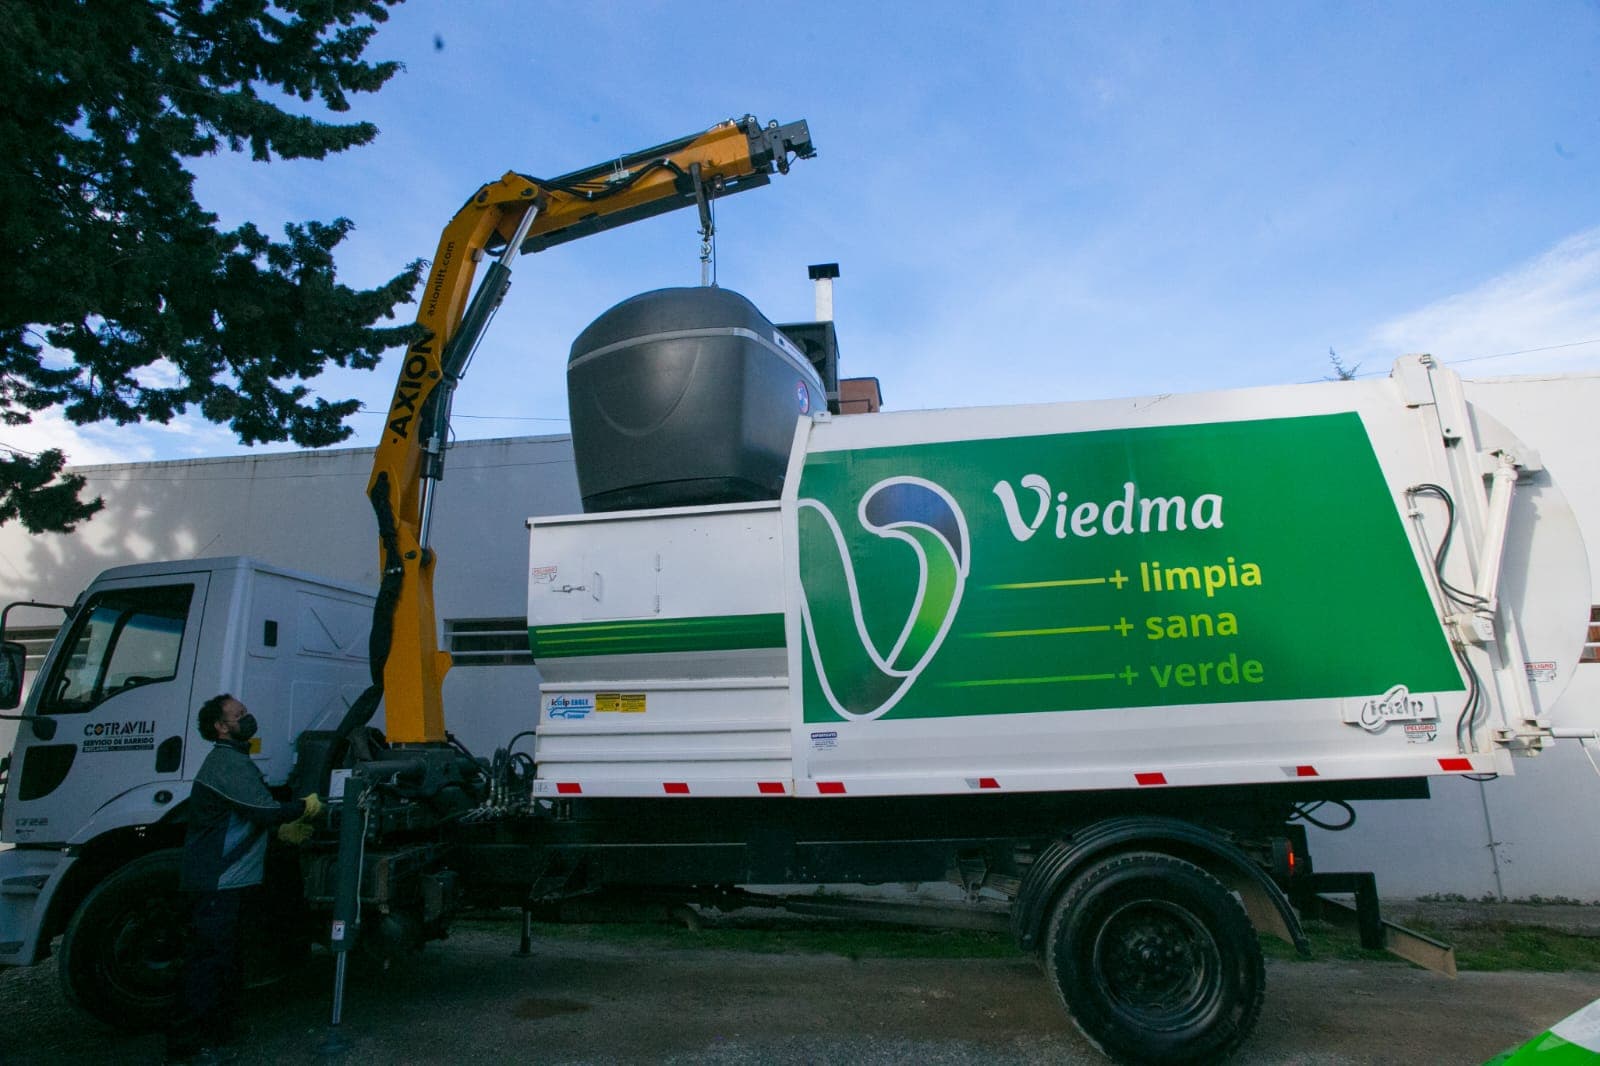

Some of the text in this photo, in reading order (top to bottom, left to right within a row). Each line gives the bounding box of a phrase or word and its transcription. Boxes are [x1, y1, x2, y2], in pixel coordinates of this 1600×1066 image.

[427, 241, 455, 317] axionlift.com
[992, 473, 1224, 542] Viedma
[1139, 557, 1262, 598] limpia
[1145, 609, 1238, 641] sana
[1150, 653, 1264, 688] verde
[83, 738, 112, 746] SERVICIO
[124, 737, 154, 745] BARRIDO
[84, 720, 155, 736] COTRAVILI
